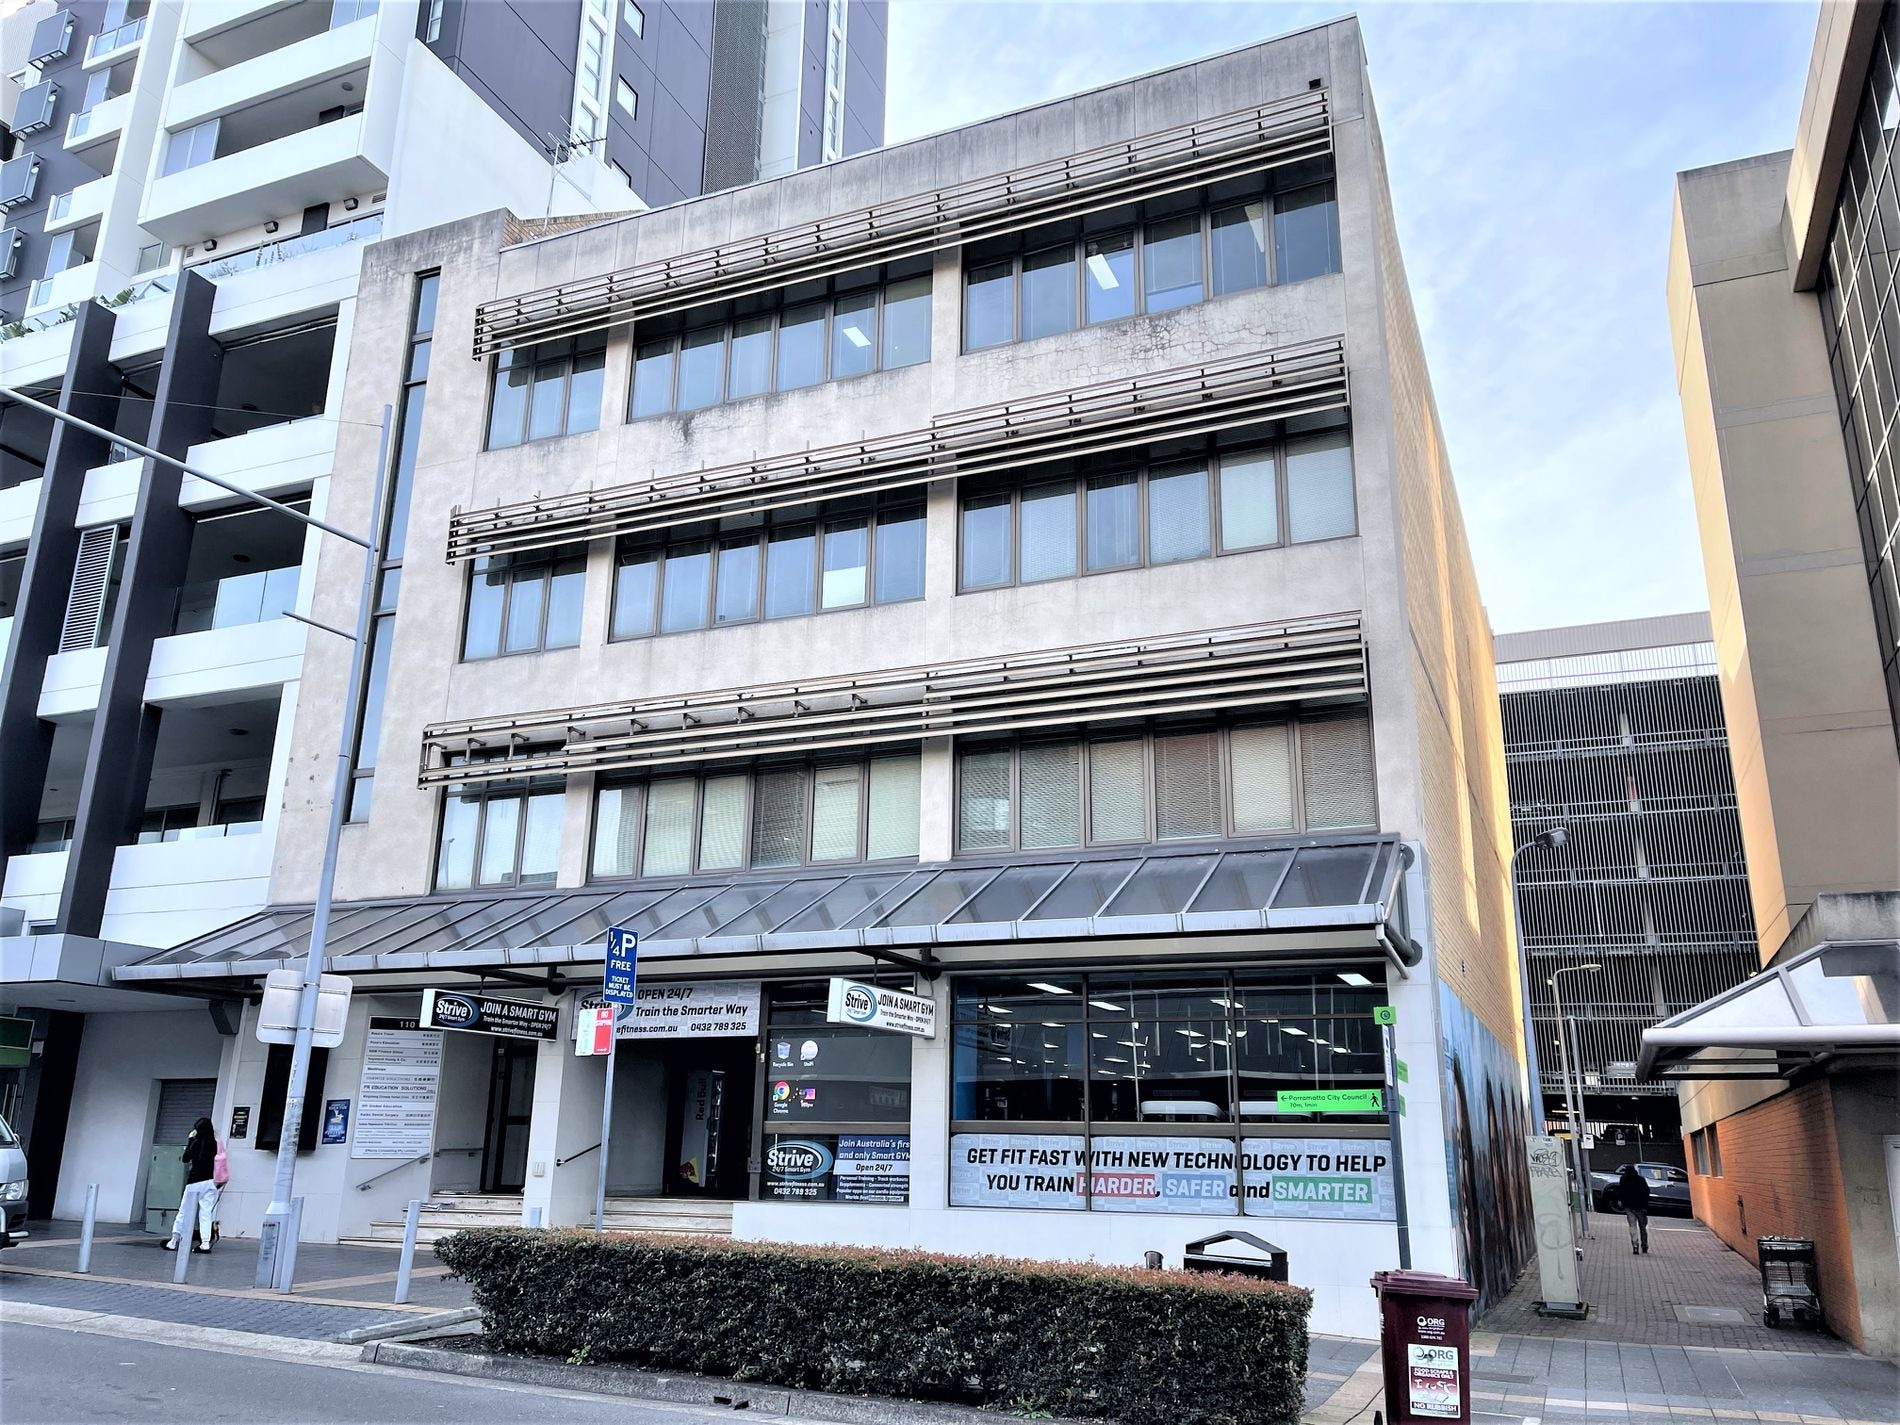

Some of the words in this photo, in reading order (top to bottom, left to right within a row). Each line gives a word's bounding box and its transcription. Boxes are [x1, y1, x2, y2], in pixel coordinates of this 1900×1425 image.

[610, 959, 631, 971] FREE
[611, 975, 629, 984] TICKET
[605, 988, 634, 998] DISPLAYED
[638, 988, 665, 1000] OPEN
[667, 987, 693, 1001] 24/7
[845, 992, 869, 1011] Strive
[878, 993, 894, 1008] JOIN
[894, 997, 899, 1009] A
[899, 998, 921, 1013] SMART
[920, 1003, 934, 1017] GYM
[436, 1000, 468, 1017] Strive
[480, 1001, 502, 1015] JOIN
[502, 1005, 508, 1016] A
[509, 1006, 538, 1019] SMART
[538, 1010, 557, 1022] GYM
[636, 1006, 660, 1018] Train
[662, 1006, 678, 1016] the
[680, 1004, 722, 1016] Smarter
[725, 1003, 748, 1016] Way
[483, 1015, 495, 1023] Train
[502, 1018, 518, 1026] Smarter
[616, 1024, 678, 1035] efitness.com.au
[690, 1022, 711, 1032] 0432
[713, 1022, 729, 1032] 789
[730, 1022, 747, 1031] 325
[1327, 1094, 1340, 1102] City
[1341, 1093, 1368, 1101] Council
[696, 1099, 706, 1120] Red
[839, 1140, 856, 1148] Join
[856, 1139, 896, 1148] Australia's
[897, 1140, 910, 1150] firs
[767, 1149, 814, 1167] Strive
[839, 1151, 853, 1159] and
[854, 1152, 870, 1161] only
[871, 1151, 894, 1159] Smart
[967, 1147, 998, 1164] GET
[1000, 1148, 1026, 1164] FIT
[1029, 1149, 1071, 1166] FAST
[1074, 1150, 1123, 1167] WITH
[1128, 1151, 1169, 1167] NEW
[1173, 1152, 1302, 1171] TECHNOLOGY
[1306, 1154, 1331, 1171] TO
[1335, 1155, 1386, 1172] HELP
[855, 1163, 874, 1173] Open
[874, 1163, 893, 1173] 24/7
[840, 1181, 865, 1189] Supplements
[987, 1174, 1020, 1191] YOU
[1025, 1175, 1075, 1192] TRAIN
[1078, 1177, 1160, 1197] HARDER,
[1165, 1178, 1225, 1197] SAFER
[1229, 1182, 1270, 1198] and
[1274, 1181, 1368, 1200] SMARTER
[804, 1188, 818, 1196] 325
[1427, 1317, 1446, 1326] ORG
[1428, 1348, 1454, 1360] ORG
[1427, 1403, 1457, 1412] RUBBISH
